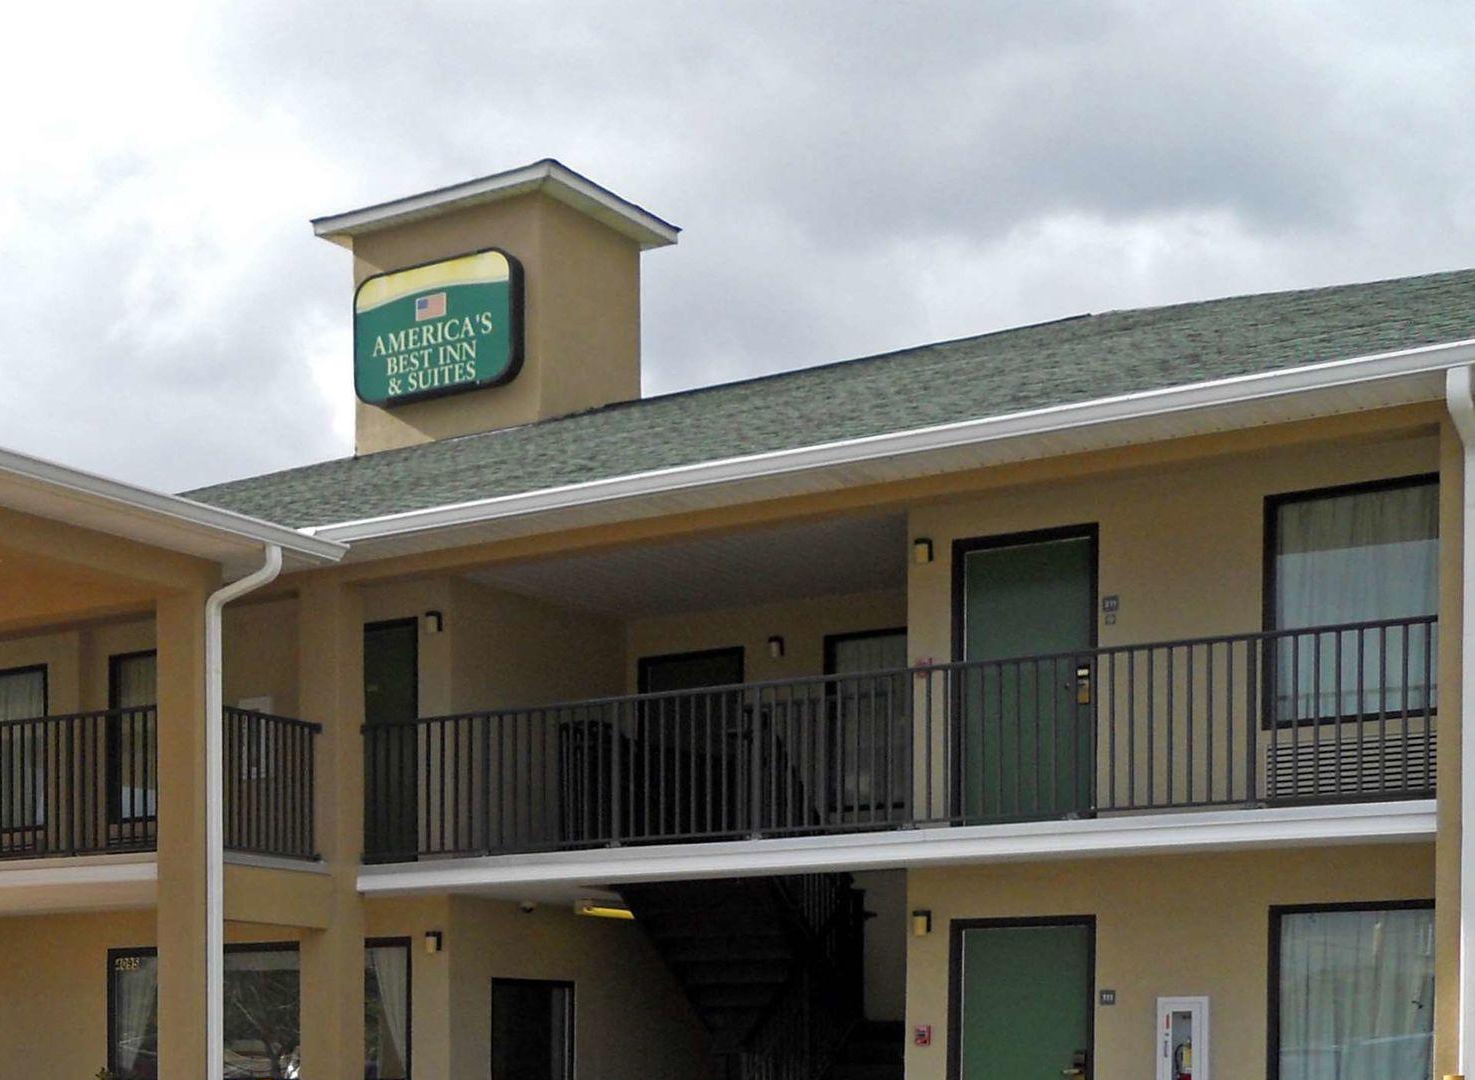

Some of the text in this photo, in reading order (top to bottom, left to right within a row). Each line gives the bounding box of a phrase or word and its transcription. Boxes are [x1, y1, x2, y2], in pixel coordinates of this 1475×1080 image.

[372, 311, 493, 357] AMERICA'S
[386, 339, 476, 376] BEST INN
[388, 360, 476, 396] & SUITES
